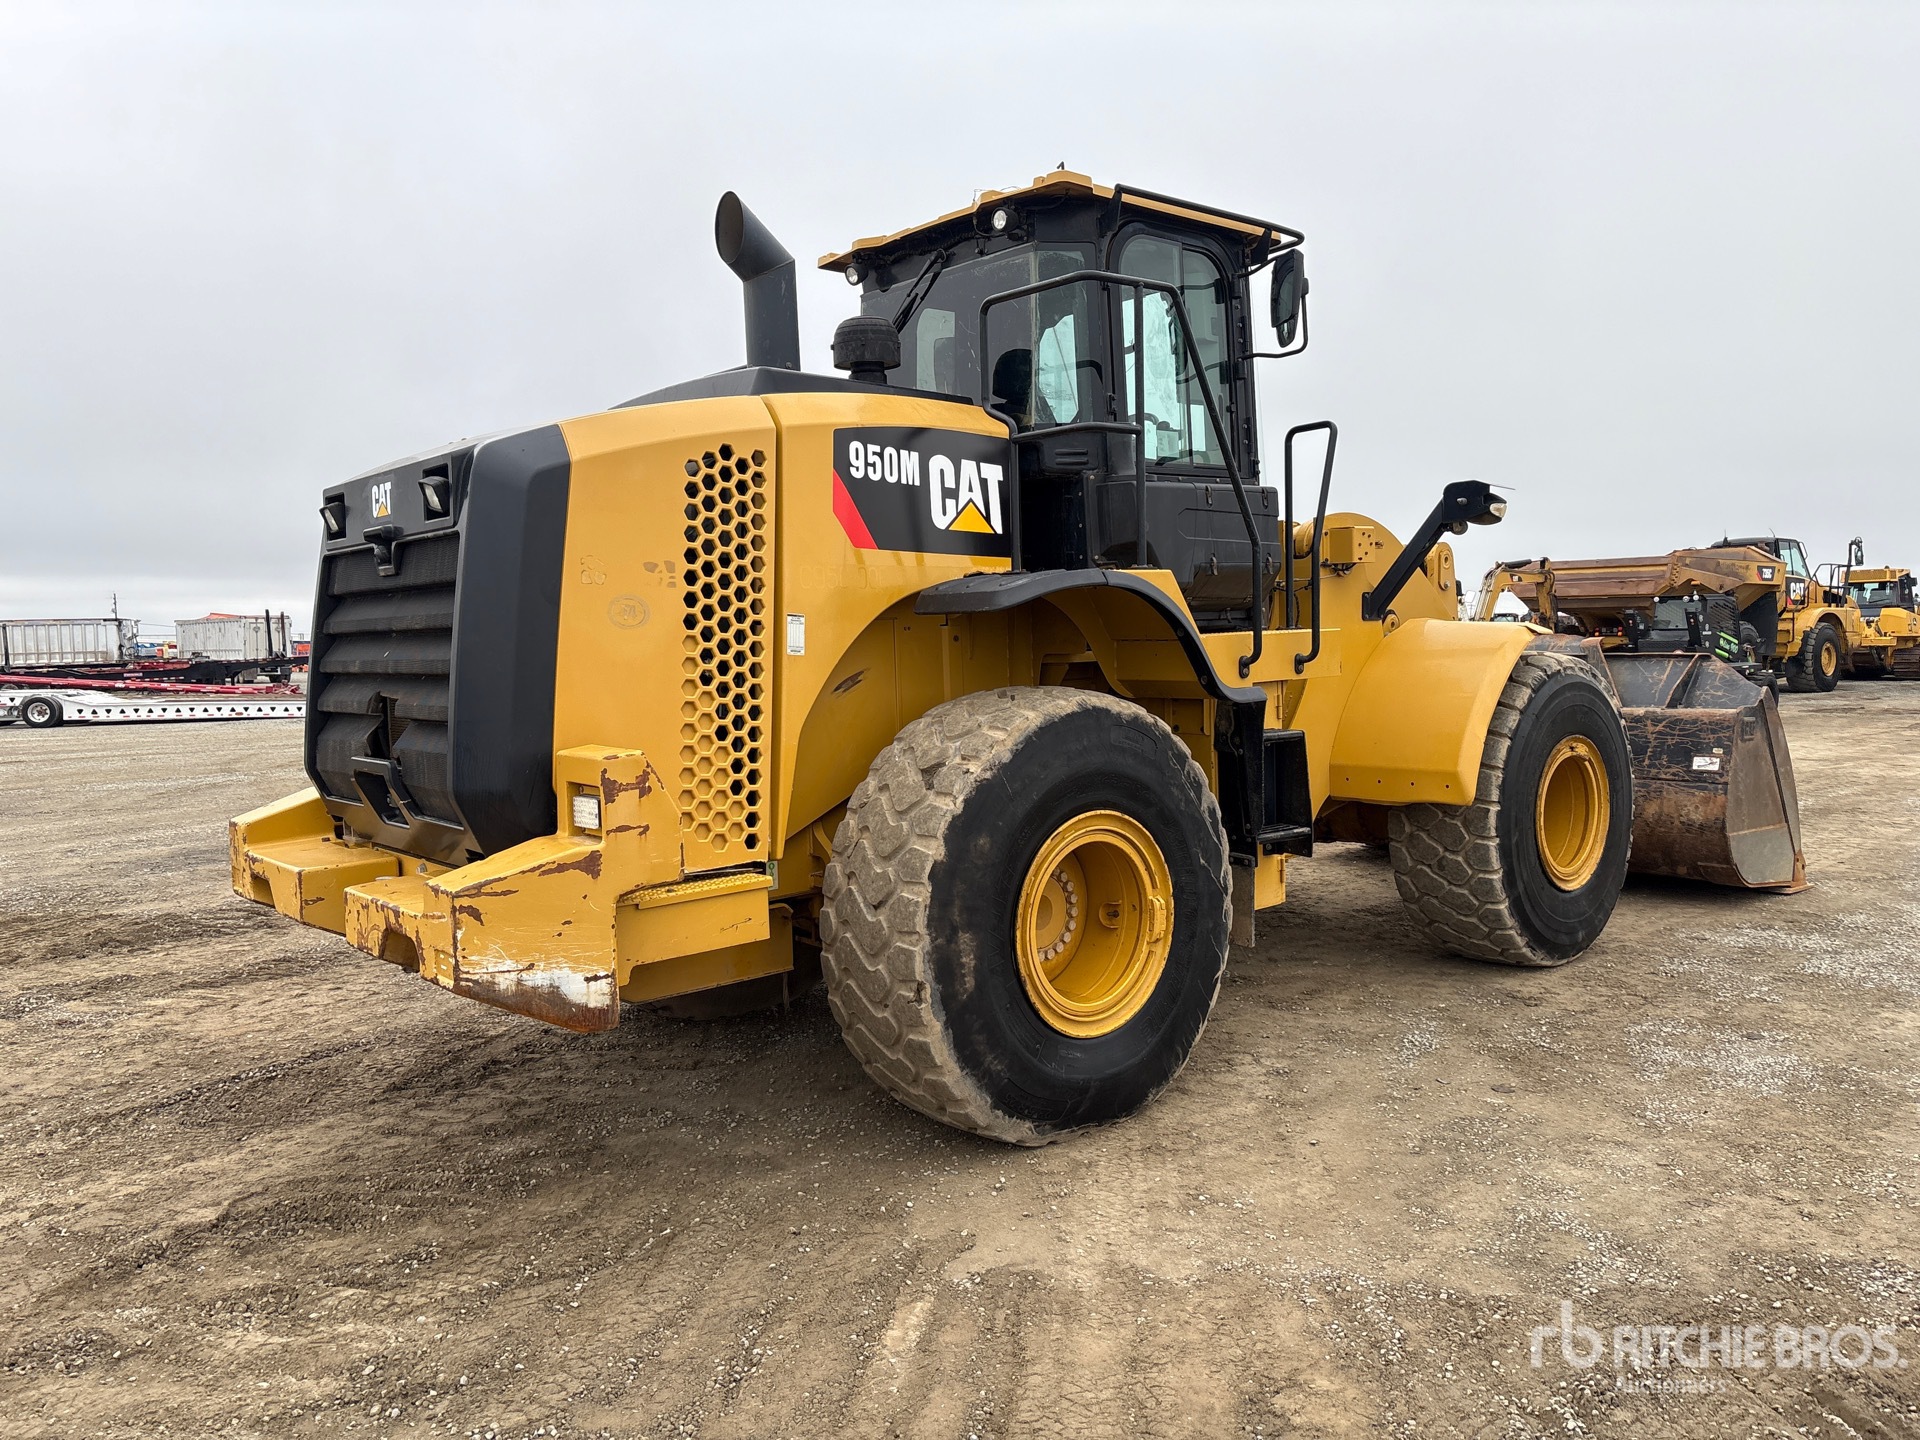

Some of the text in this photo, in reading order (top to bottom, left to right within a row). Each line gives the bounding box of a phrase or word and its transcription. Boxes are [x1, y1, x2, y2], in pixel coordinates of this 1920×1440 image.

[849, 440, 920, 486] 950M
[371, 481, 392, 518] CAT
[928, 454, 1004, 535] CAT
[1790, 582, 1805, 601] CAT
